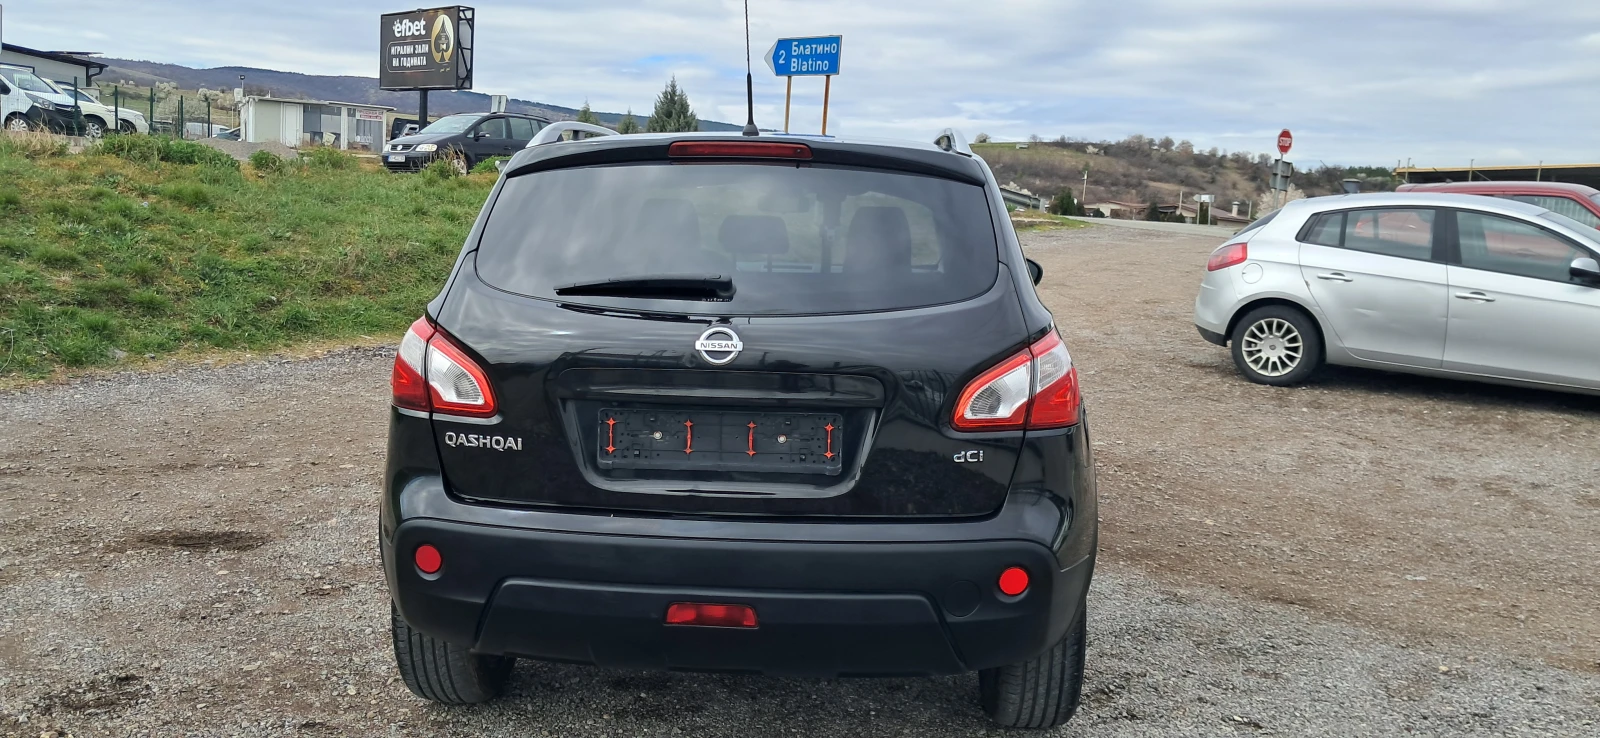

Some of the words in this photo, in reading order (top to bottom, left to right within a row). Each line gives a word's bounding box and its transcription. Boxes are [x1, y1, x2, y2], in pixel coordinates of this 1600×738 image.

[393, 18, 426, 38] efbet
[390, 45, 414, 56] ИГРАЛНИ
[414, 44, 429, 54] ЗАЛИ
[778, 50, 786, 64] 2
[791, 41, 838, 56] Блатино
[392, 57, 400, 67] НА
[400, 56, 427, 68] ГОДИНАТА
[790, 58, 829, 72] Blatino
[1279, 137, 1292, 147] STOP
[700, 342, 738, 350] NISSAN
[444, 431, 523, 452] QASHQAI
